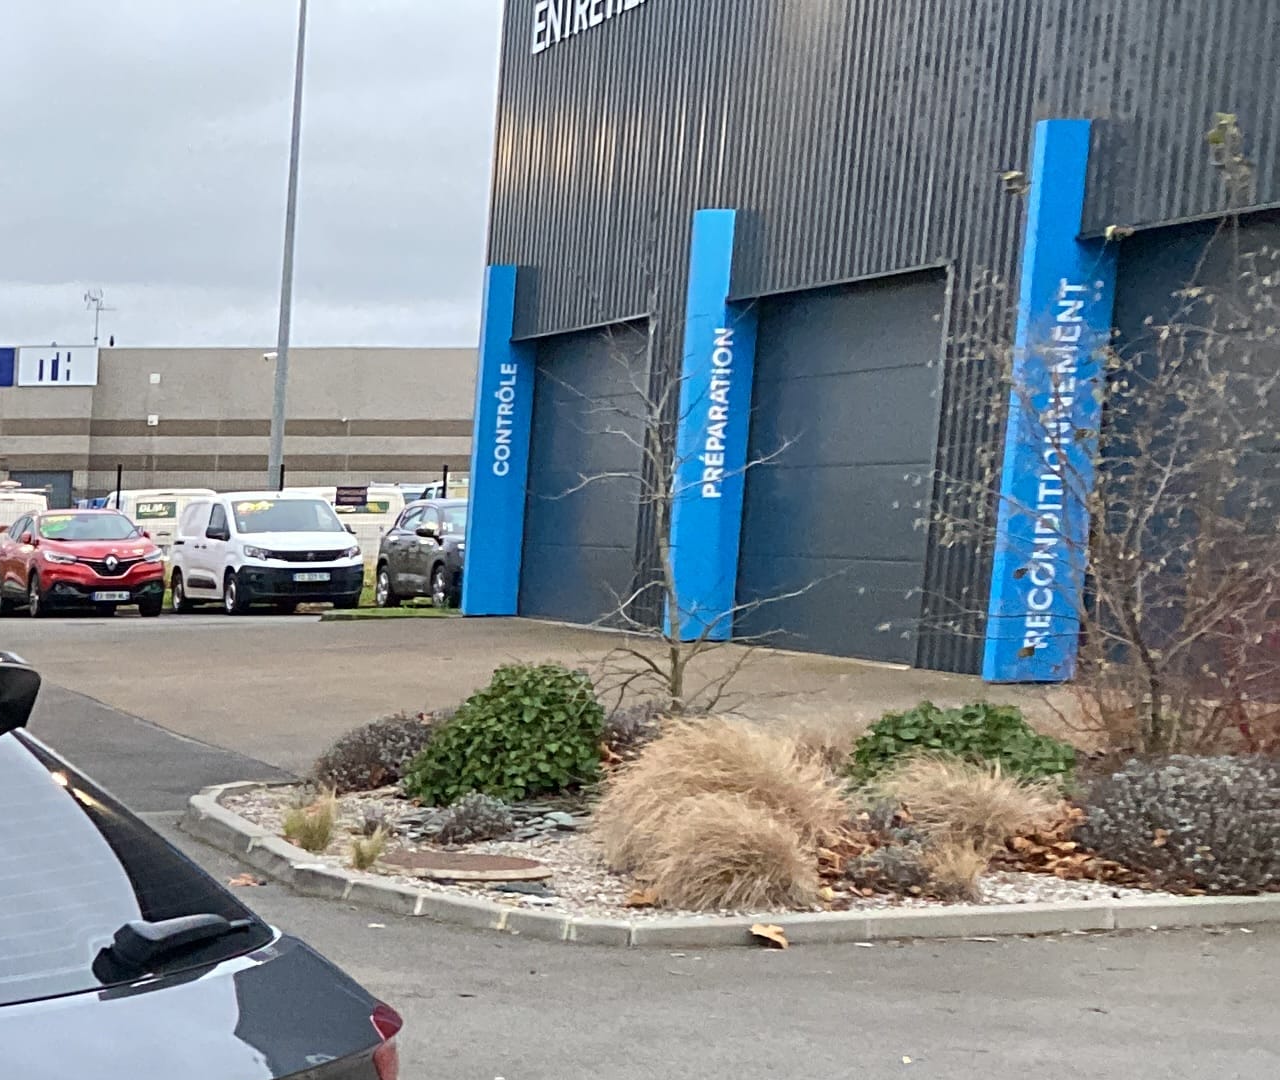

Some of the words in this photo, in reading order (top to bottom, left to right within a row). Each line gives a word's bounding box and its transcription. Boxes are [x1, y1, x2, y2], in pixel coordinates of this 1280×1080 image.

[532, 0, 646, 54] ENTRE
[492, 363, 517, 477] CONTRÔLE
[702, 328, 735, 498] PRÉPARATION
